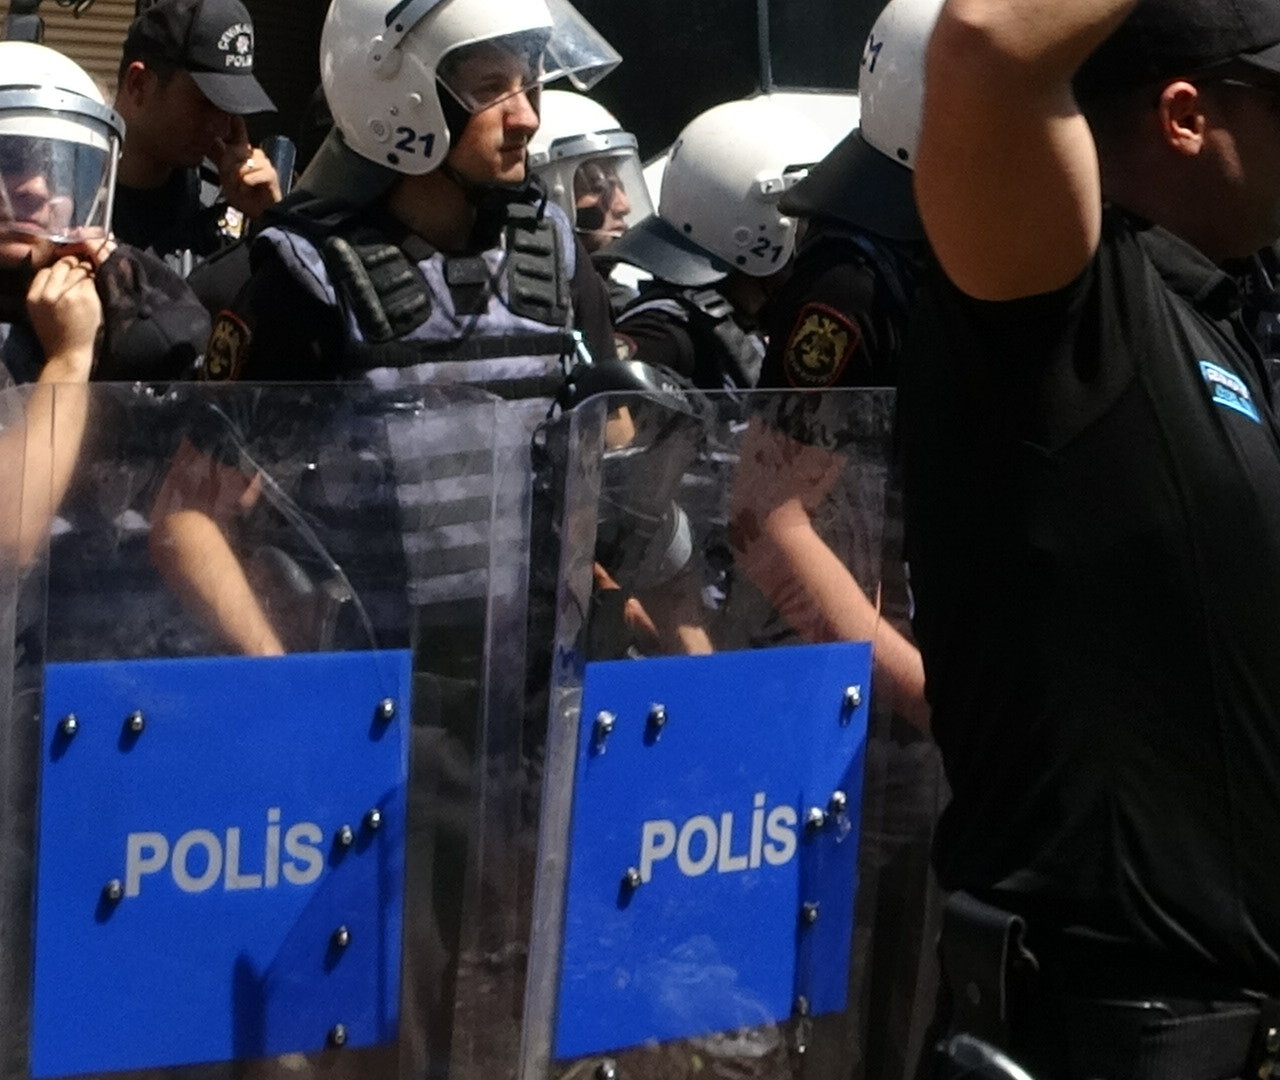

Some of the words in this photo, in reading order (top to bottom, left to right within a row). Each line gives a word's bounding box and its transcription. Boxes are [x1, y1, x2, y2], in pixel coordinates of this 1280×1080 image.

[394, 126, 436, 159] 21
[749, 237, 783, 264] 21
[125, 807, 325, 898] POLİS
[640, 791, 798, 884] POLİS
